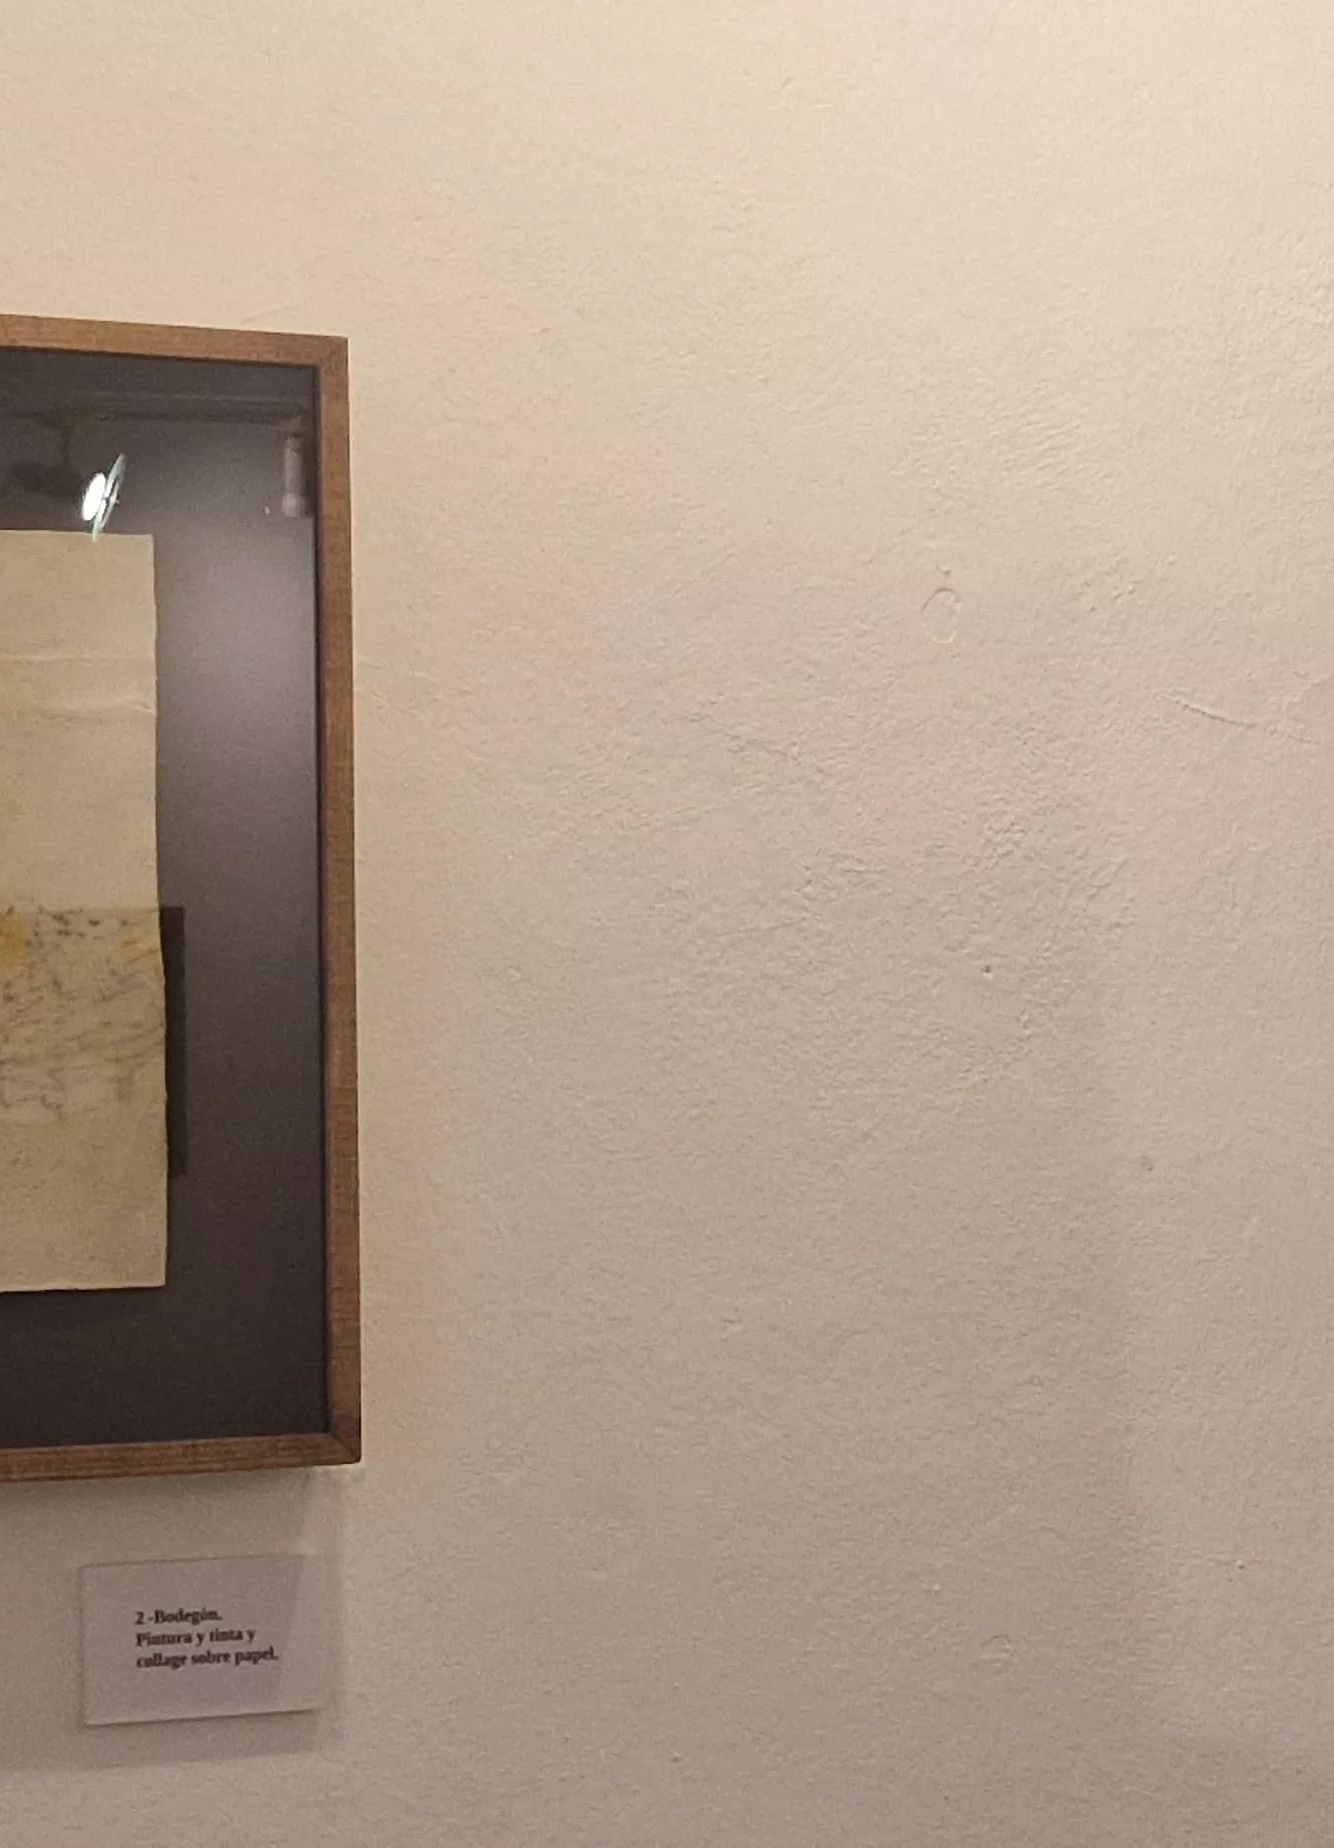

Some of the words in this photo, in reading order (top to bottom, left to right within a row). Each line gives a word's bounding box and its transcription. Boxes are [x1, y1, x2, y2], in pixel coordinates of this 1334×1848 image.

[135, 1631, 192, 1647] Pintura
[195, 1633, 205, 1646] y
[209, 1628, 244, 1643] tinta
[247, 1629, 256, 1643] y
[136, 1652, 187, 1670] collage
[191, 1649, 231, 1665] sobre
[234, 1646, 279, 1665] papel.
